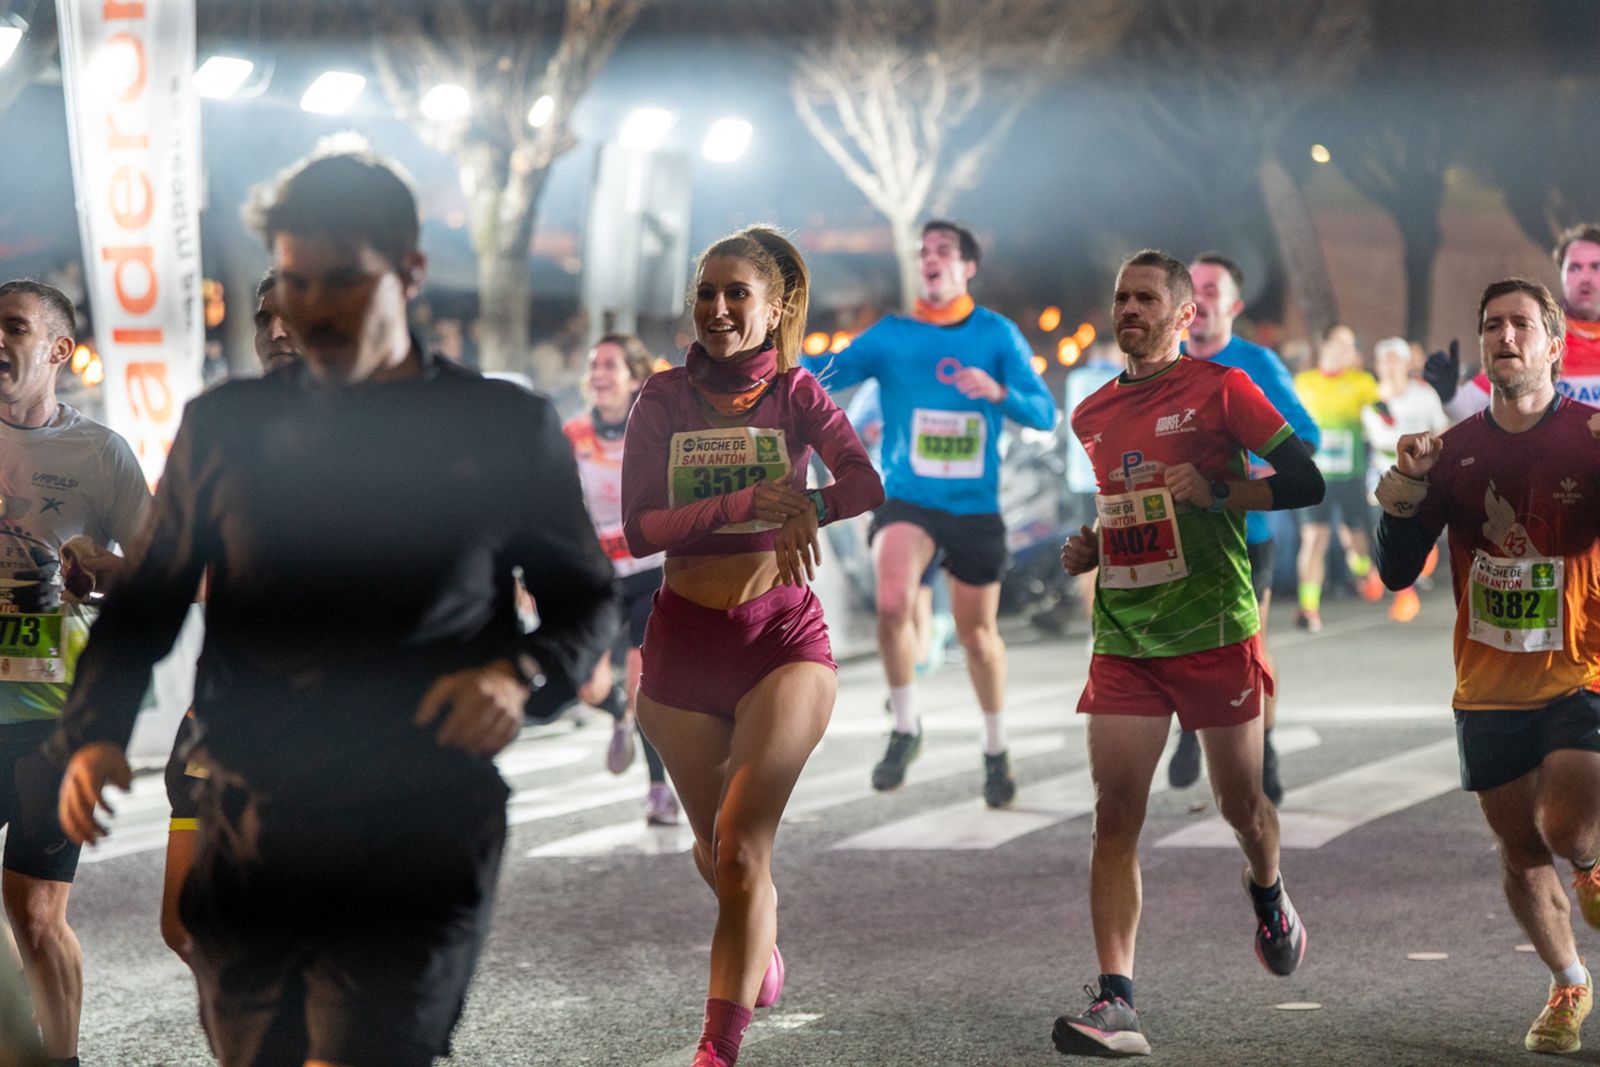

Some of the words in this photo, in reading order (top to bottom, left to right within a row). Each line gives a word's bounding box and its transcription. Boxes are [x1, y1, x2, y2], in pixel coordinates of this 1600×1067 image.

[696, 440, 731, 451] NOCHE
[733, 440, 746, 450] DE
[682, 455, 705, 466] SAN
[708, 451, 746, 465] ANTÓN
[1123, 503, 1135, 514] DE
[1503, 531, 1527, 556] 43
[1510, 568, 1522, 577] DE
[1483, 588, 1541, 619] 1382
